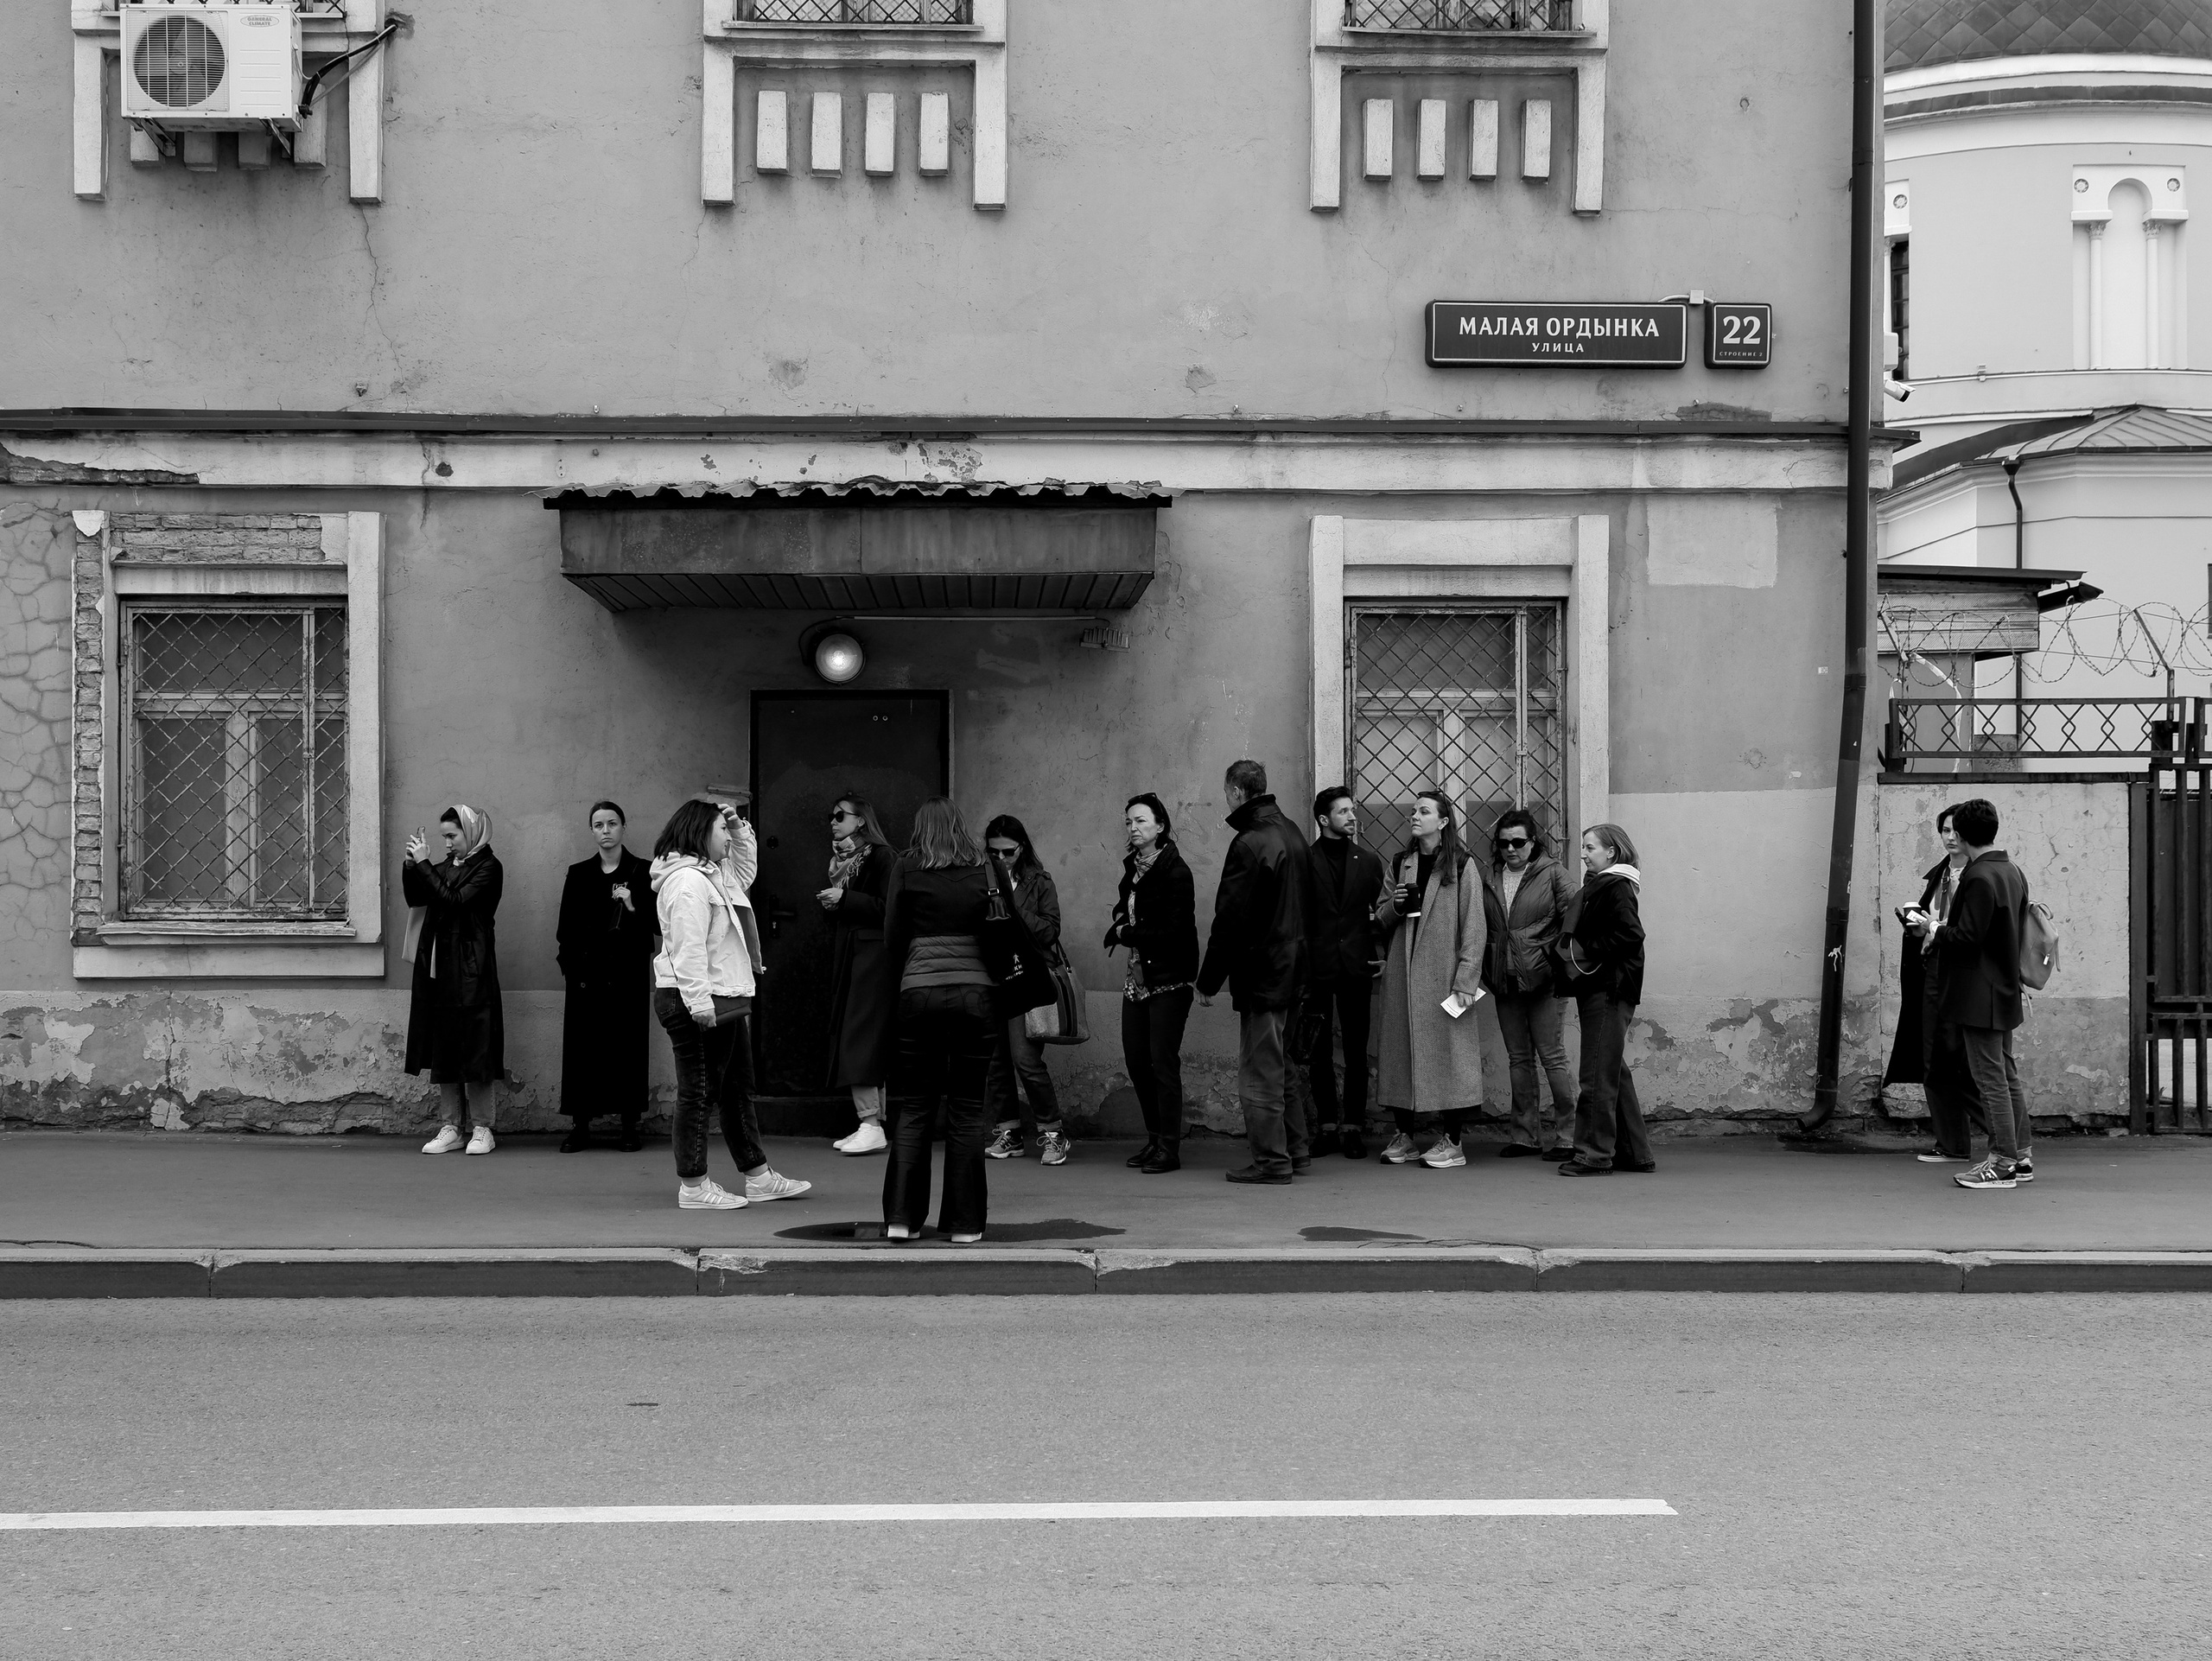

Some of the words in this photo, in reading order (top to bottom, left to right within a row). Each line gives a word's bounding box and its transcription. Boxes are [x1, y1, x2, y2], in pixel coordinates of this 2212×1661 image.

[1459, 316, 1539, 336] МАЛАЯ
[1546, 317, 1660, 339] ОРДЫНКА
[1722, 315, 1761, 345] 22
[1531, 342, 1585, 353] УЛИЦА
